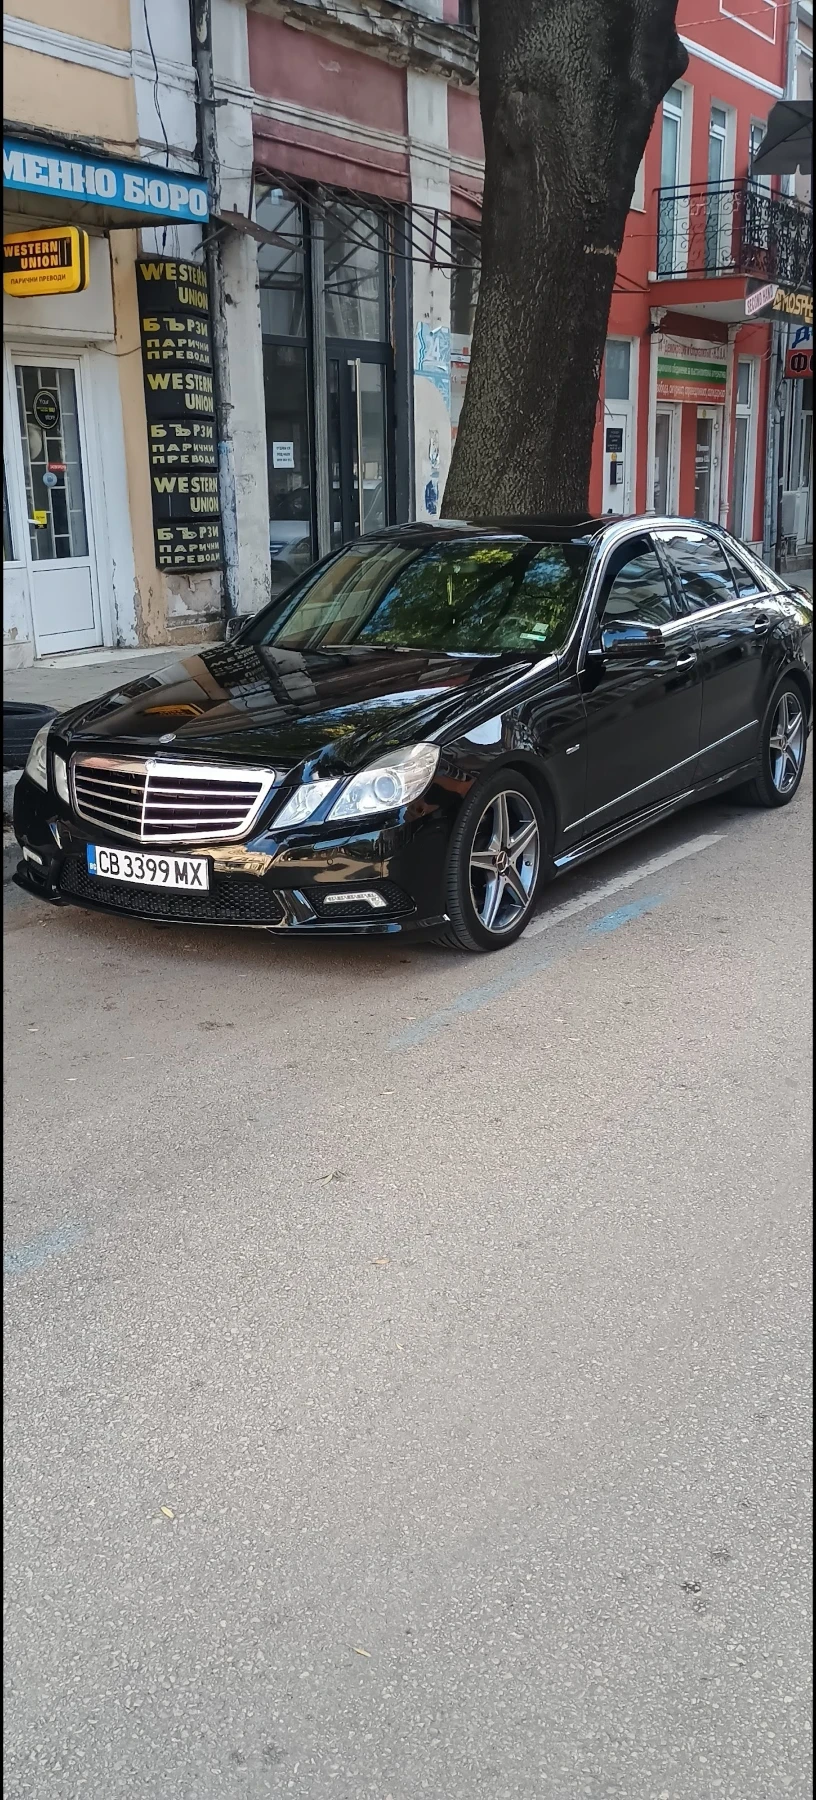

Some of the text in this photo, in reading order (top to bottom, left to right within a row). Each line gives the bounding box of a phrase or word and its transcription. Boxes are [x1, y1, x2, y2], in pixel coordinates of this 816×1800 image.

[123, 173, 208, 217] БЮРО
[4, 240, 58, 257] WESTERN
[21, 254, 58, 269] UNION
[11, 274, 66, 285] ПАРИЧНИ ПРЕВОДИ
[140, 263, 207, 288] WESTERN
[178, 287, 209, 311] UNION
[747, 292, 762, 313] SECOND
[143, 317, 208, 337] БЪРЗИ
[146, 338, 209, 352] ПАРИЧНИ
[147, 351, 210, 364] ПРЕВОДИ
[147, 373, 213, 393] WESTERN
[184, 393, 214, 413] UNION
[150, 424, 213, 439] БЪРЗИ
[152, 443, 214, 453] ПАРИЧНИ
[152, 454, 215, 464] ПРЕВОДИ
[153, 476, 218, 493] WESTERN
[189, 497, 219, 513] UNION
[157, 526, 219, 541] БЪРЗИ
[159, 542, 220, 553] ПАРИЧНИ
[160, 552, 220, 564] ПРЕВОДИ
[98, 851, 203, 886] CB 3399 MX
